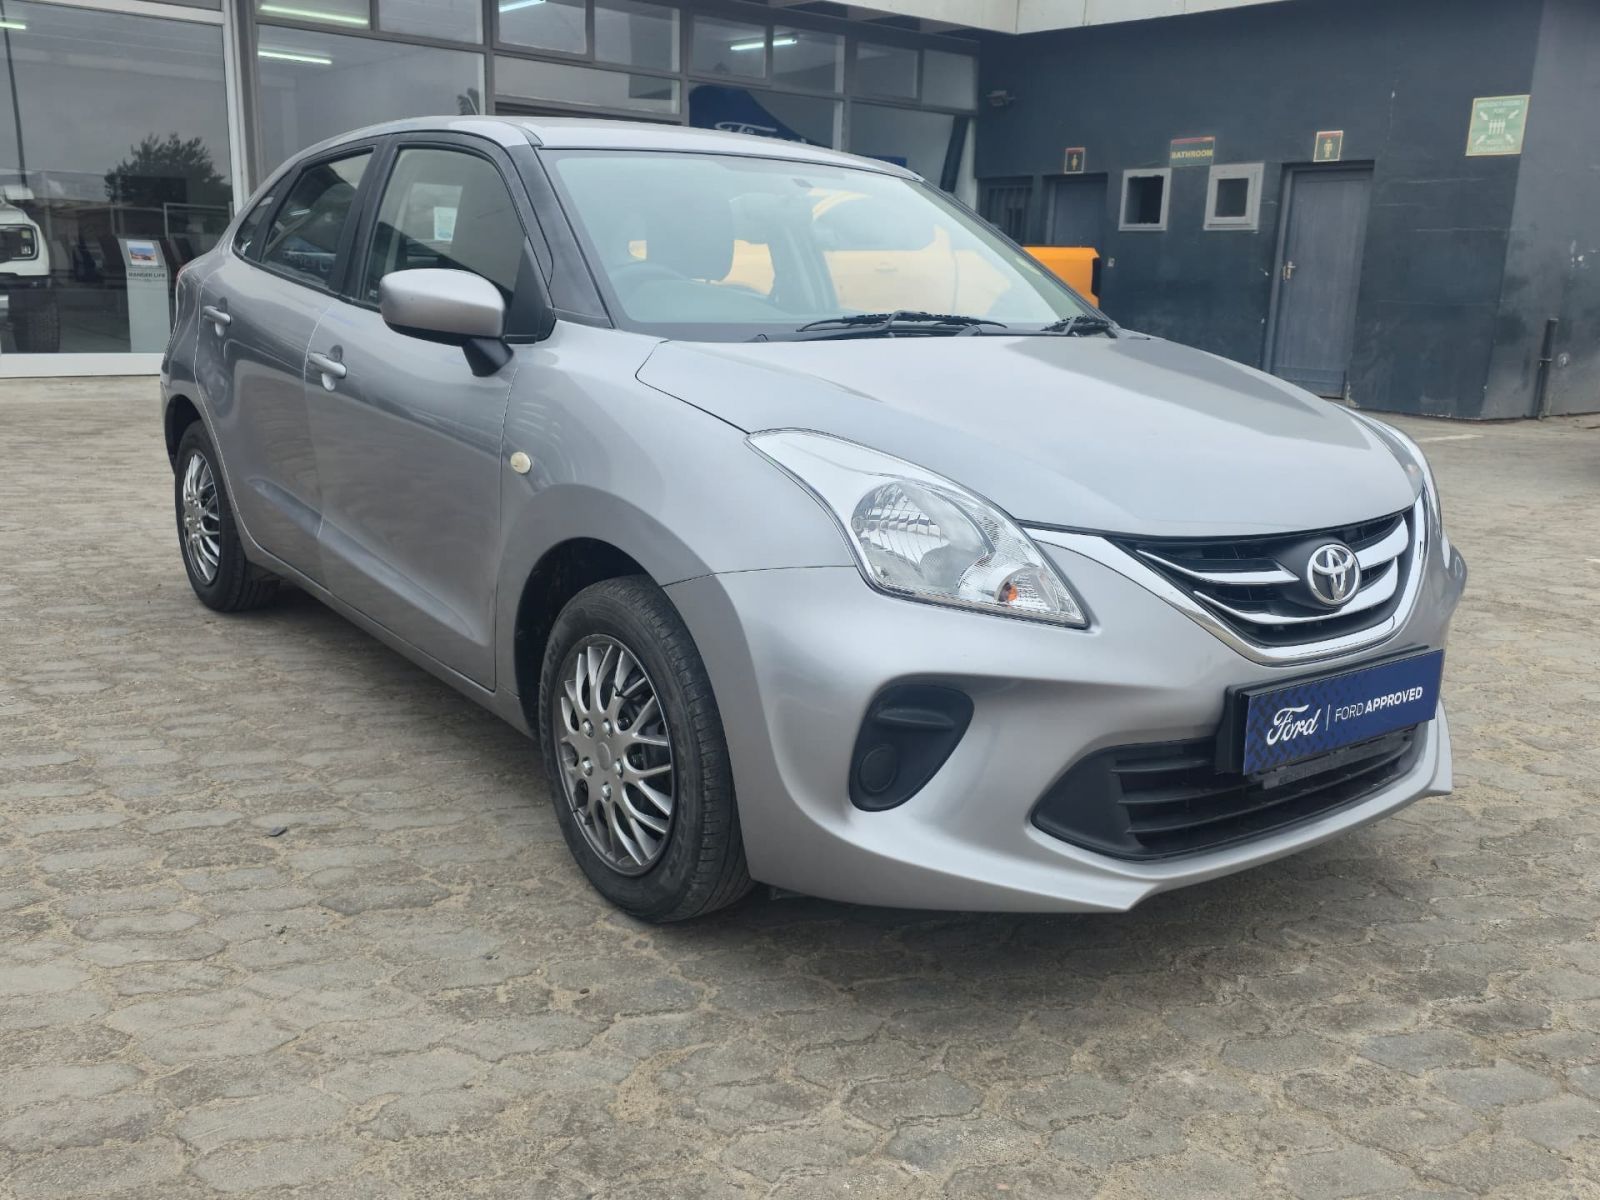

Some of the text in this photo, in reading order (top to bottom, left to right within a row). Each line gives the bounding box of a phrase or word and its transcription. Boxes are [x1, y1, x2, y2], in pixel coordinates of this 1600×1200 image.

[1171, 149, 1213, 159] BATHROOM
[1335, 686, 1423, 723] FORD APPROVED
[1266, 704, 1321, 746] Ford
